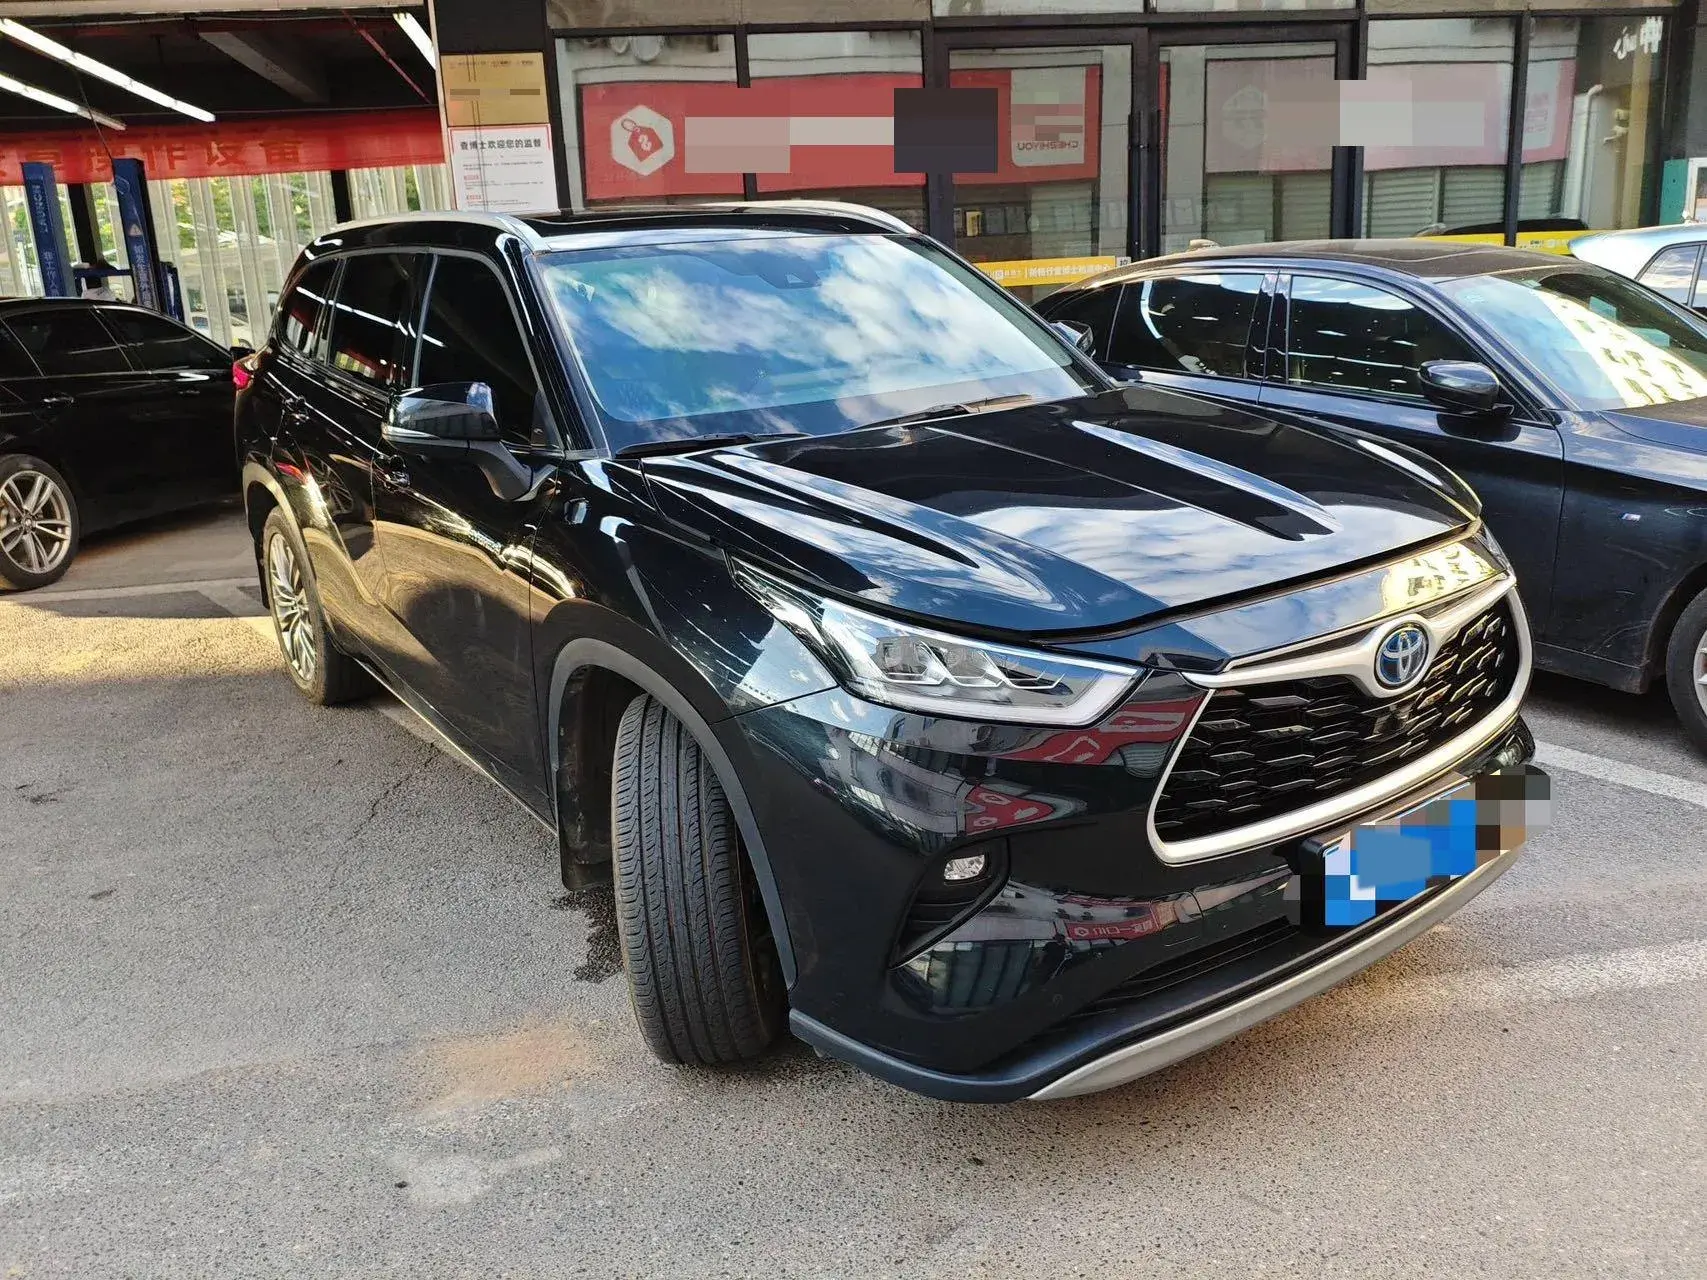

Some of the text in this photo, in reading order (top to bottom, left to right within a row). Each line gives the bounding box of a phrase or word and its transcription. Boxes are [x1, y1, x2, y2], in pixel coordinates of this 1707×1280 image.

[460, 138, 541, 150] 查博士欢迎您的监督
